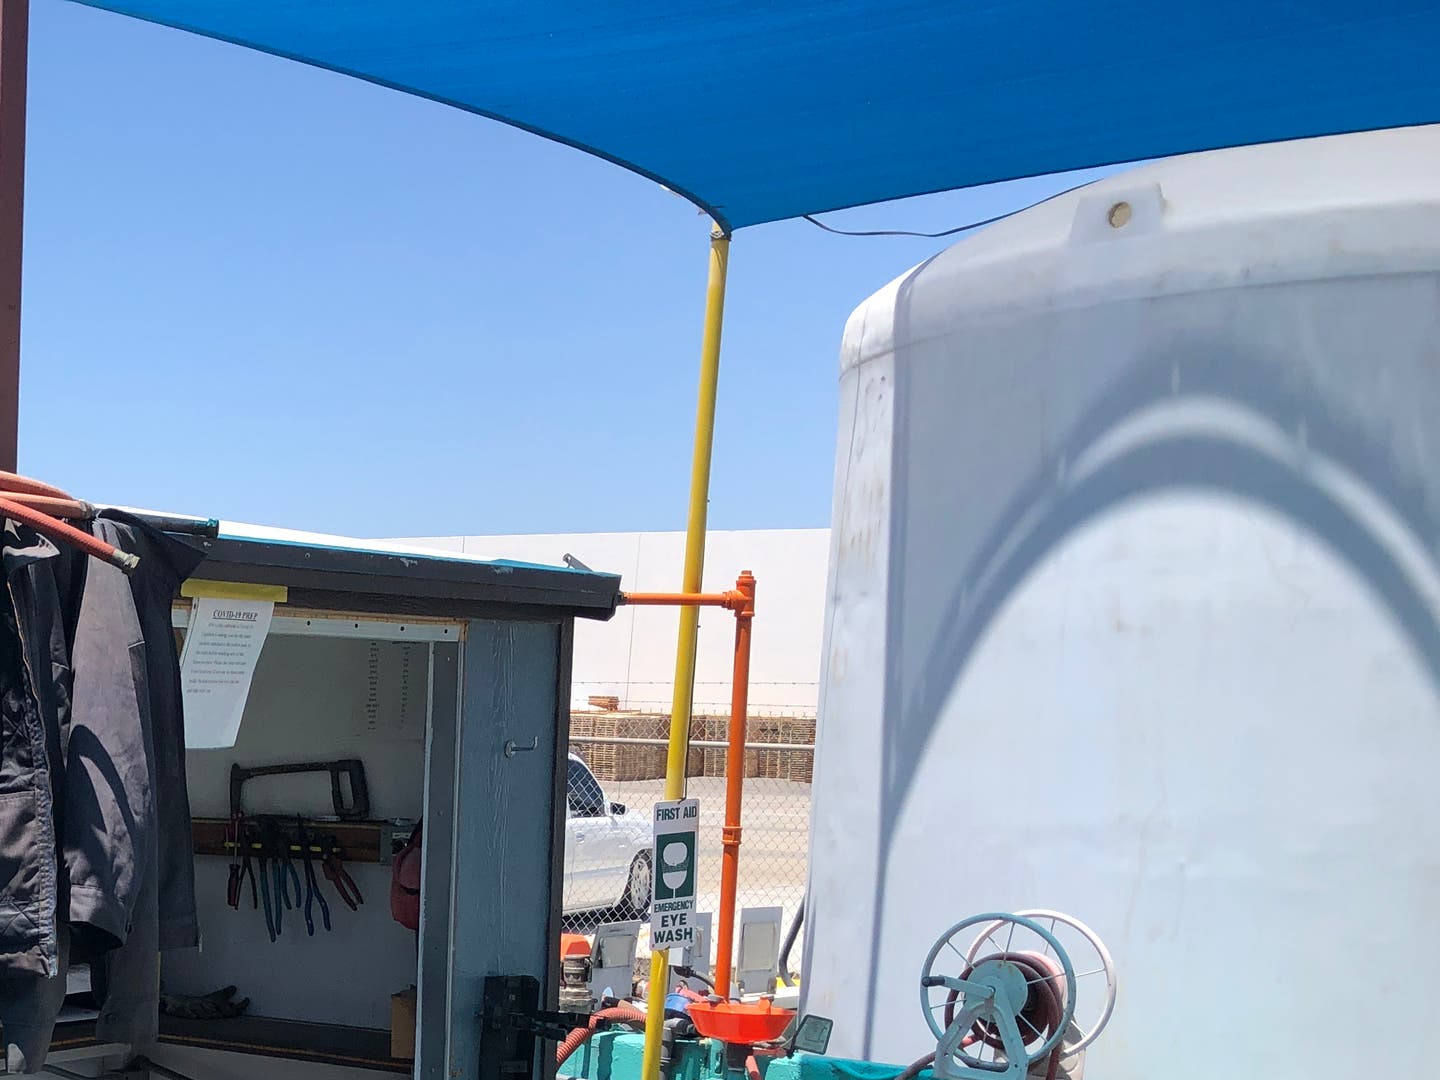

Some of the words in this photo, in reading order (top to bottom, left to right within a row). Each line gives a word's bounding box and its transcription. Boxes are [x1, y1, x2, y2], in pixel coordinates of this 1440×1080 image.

[242, 611, 259, 620] PREP
[656, 807, 680, 821] FIRST
[683, 805, 697, 819] AID
[654, 899, 694, 913] EMERGENCY
[661, 912, 687, 928] EYE
[654, 927, 693, 944] WASH
